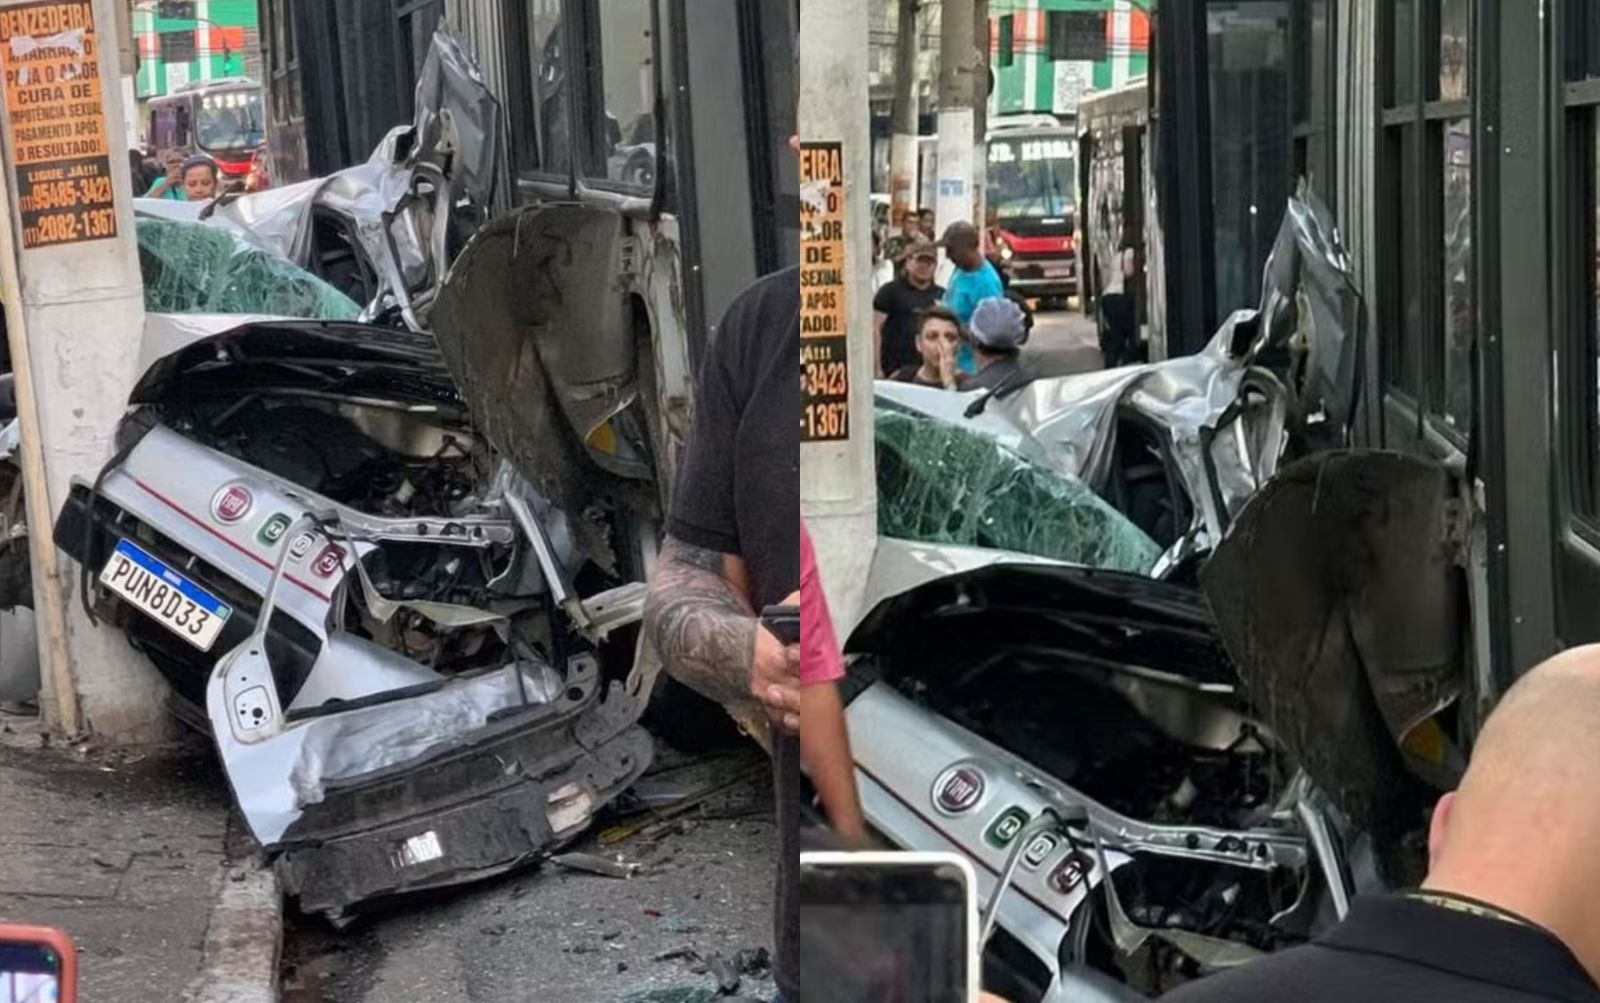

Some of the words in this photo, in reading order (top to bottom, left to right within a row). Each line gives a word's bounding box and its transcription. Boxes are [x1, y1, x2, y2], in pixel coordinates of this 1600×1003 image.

[0, 3, 94, 39] BENZEDEIRA
[45, 66, 55, 83] O
[18, 86, 65, 105] CURA
[71, 84, 91, 99] DE
[69, 102, 102, 118] SEXUAL
[15, 123, 71, 142] PAGAMENTO
[75, 119, 98, 136] APÓS
[17, 147, 25, 161] O
[27, 139, 101, 159] RESULTADO!
[28, 168, 63, 182] LIGUE
[806, 246, 833, 263] DE
[801, 269, 843, 287] SEXUAL
[806, 290, 836, 310] APÓS
[800, 315, 837, 333] ADO!
[111, 558, 210, 635] PUN8D33
